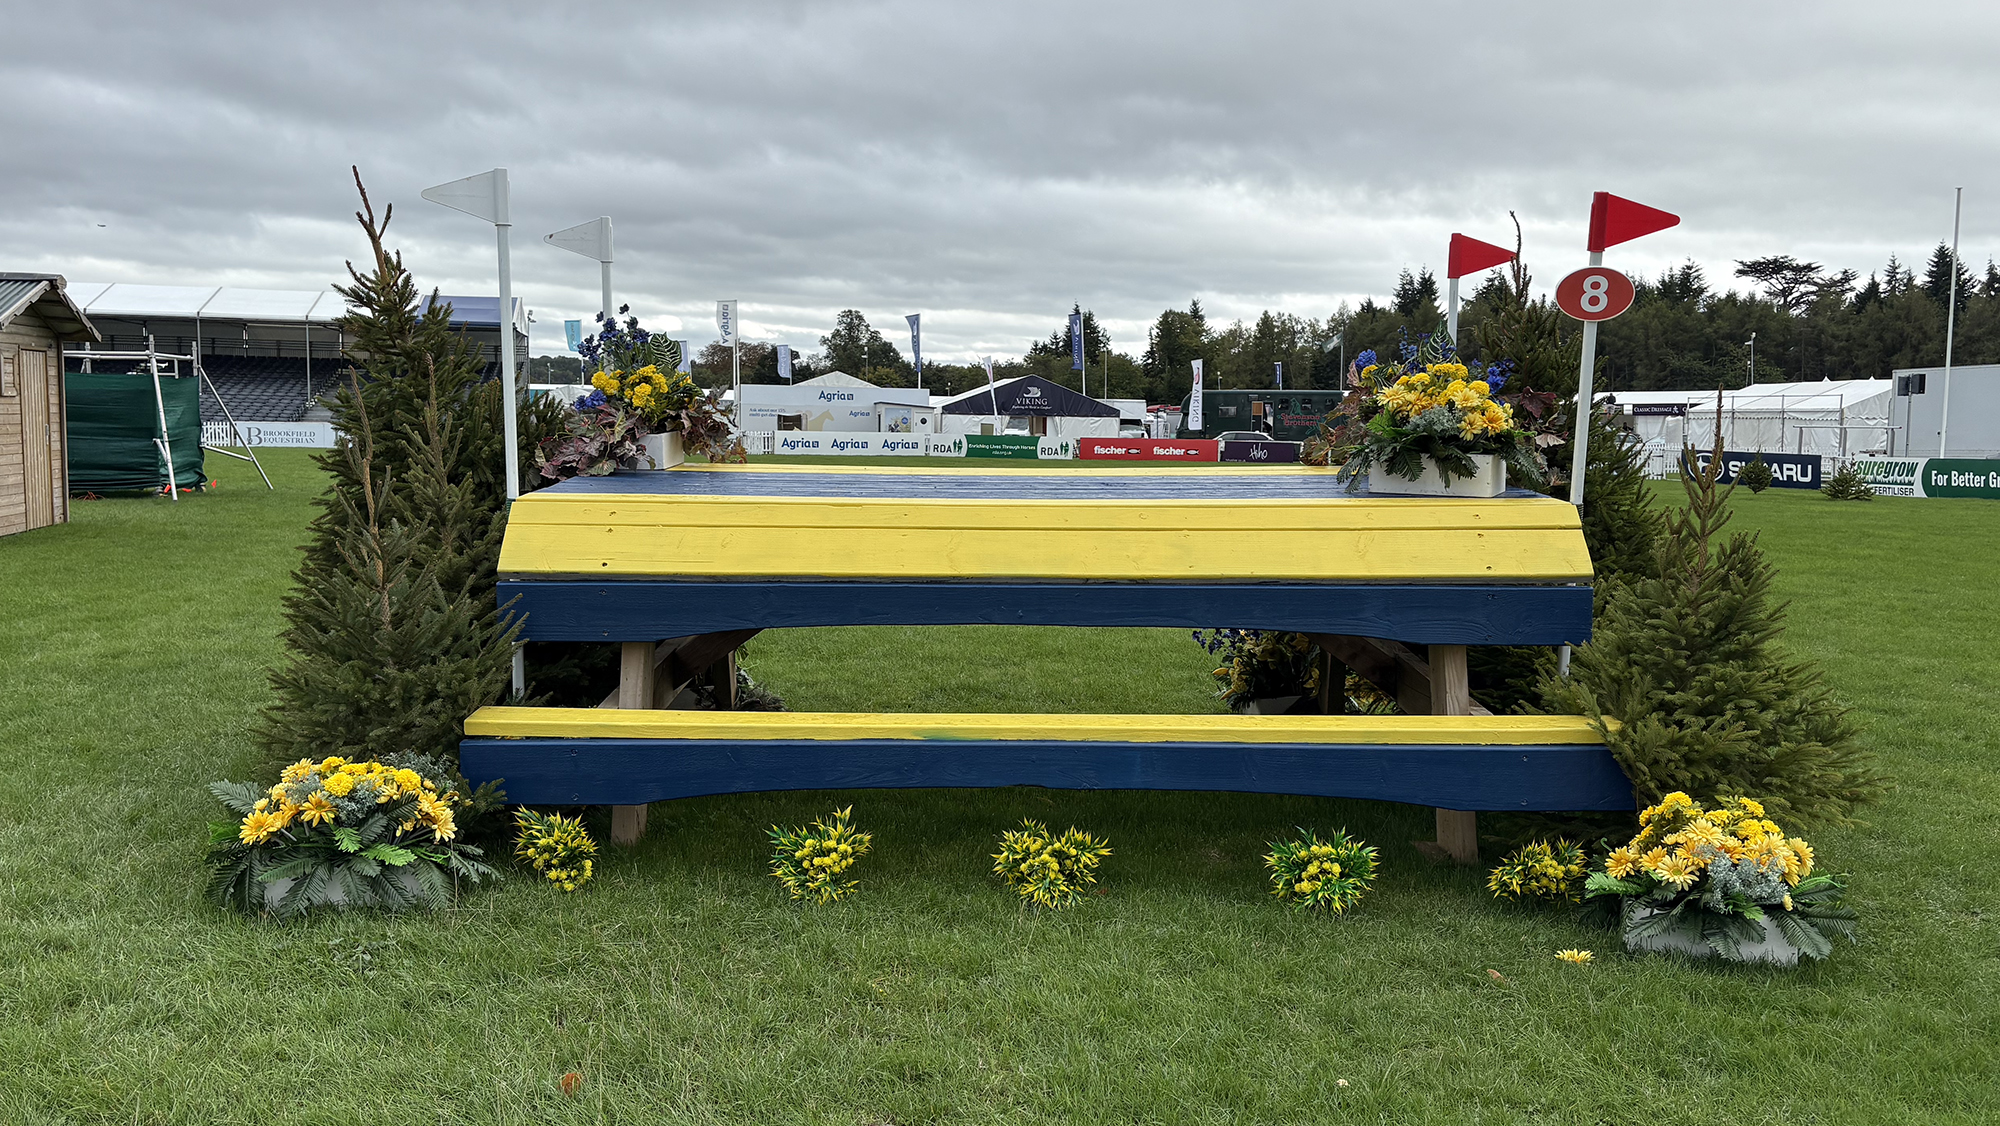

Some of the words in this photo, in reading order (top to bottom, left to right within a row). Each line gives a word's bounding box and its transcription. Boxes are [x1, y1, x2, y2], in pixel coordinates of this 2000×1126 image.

[1580, 275, 1609, 313] 8
[818, 390, 847, 402] Agria
[781, 438, 811, 450] Agria
[831, 439, 861, 451] Agria
[882, 439, 910, 451] Agria
[933, 445, 952, 453] RDA
[1041, 447, 1059, 456] RDA
[1094, 446, 1127, 455] fischer
[1153, 447, 1186, 456] fischer
[1728, 461, 1812, 482] SARU
[1857, 460, 1919, 478] suregrow
[1931, 470, 1949, 486] For
[1951, 470, 1986, 488] Better
[1874, 486, 1915, 496] FERTILISER
